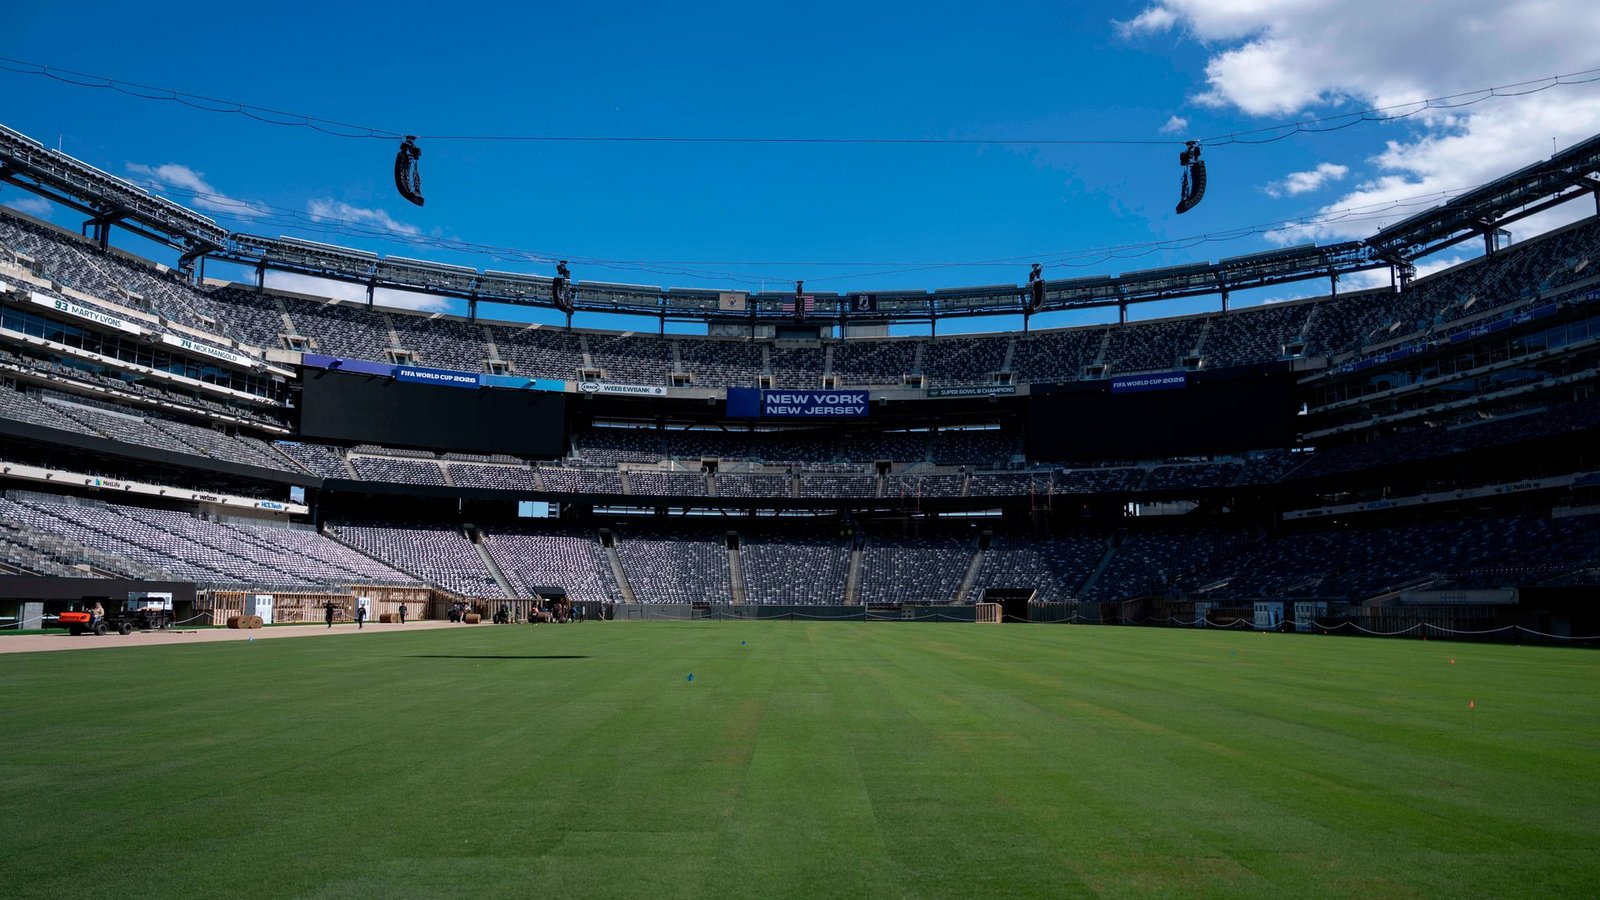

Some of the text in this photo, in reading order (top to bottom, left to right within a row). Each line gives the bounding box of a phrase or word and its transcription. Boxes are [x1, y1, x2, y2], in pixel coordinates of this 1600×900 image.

[54, 300, 122, 327] 93 MARTY LYONS
[181, 339, 238, 361] 74 NICK MANGOLD
[454, 375, 476, 383] 2026
[1162, 376, 1185, 384] 2026
[766, 394, 865, 404] NEW YORK
[766, 406, 865, 415] NEW JERSEY
[102, 479, 121, 488] MetLife
